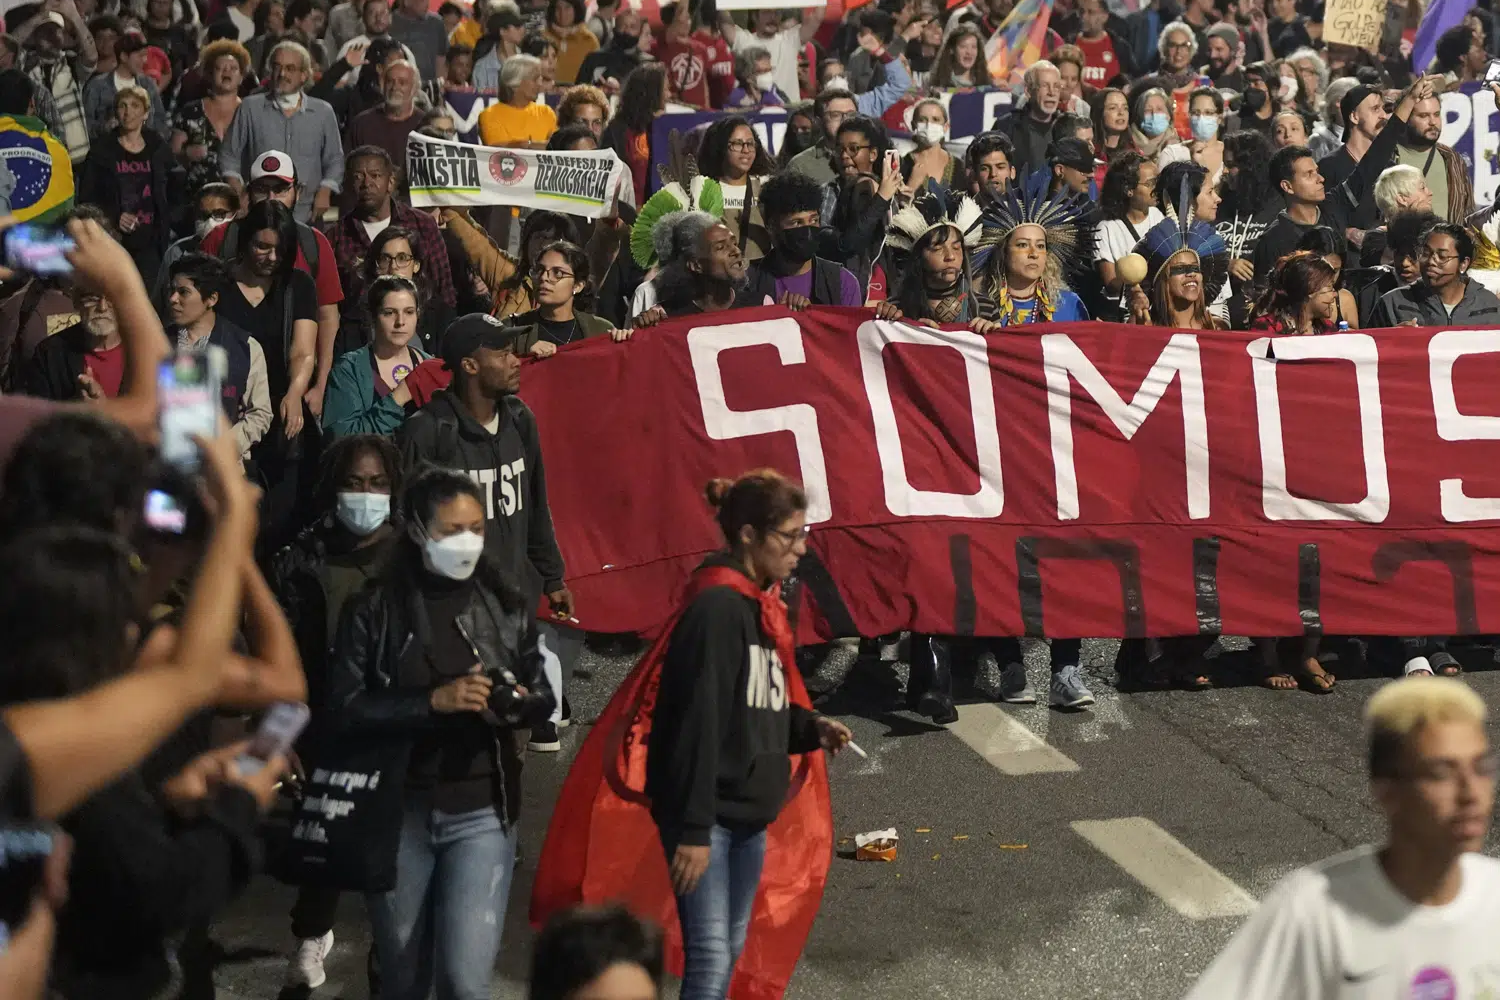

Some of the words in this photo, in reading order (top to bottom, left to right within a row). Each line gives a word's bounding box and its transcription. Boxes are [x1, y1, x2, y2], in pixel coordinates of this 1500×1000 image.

[409, 141, 476, 158] SEM
[536, 153, 552, 165] EM
[555, 154, 597, 170] DEFESA
[598, 159, 614, 171] DA
[409, 157, 480, 187] ANISTIA
[534, 164, 609, 200] DEMOCRACIA
[458, 457, 525, 519] TST
